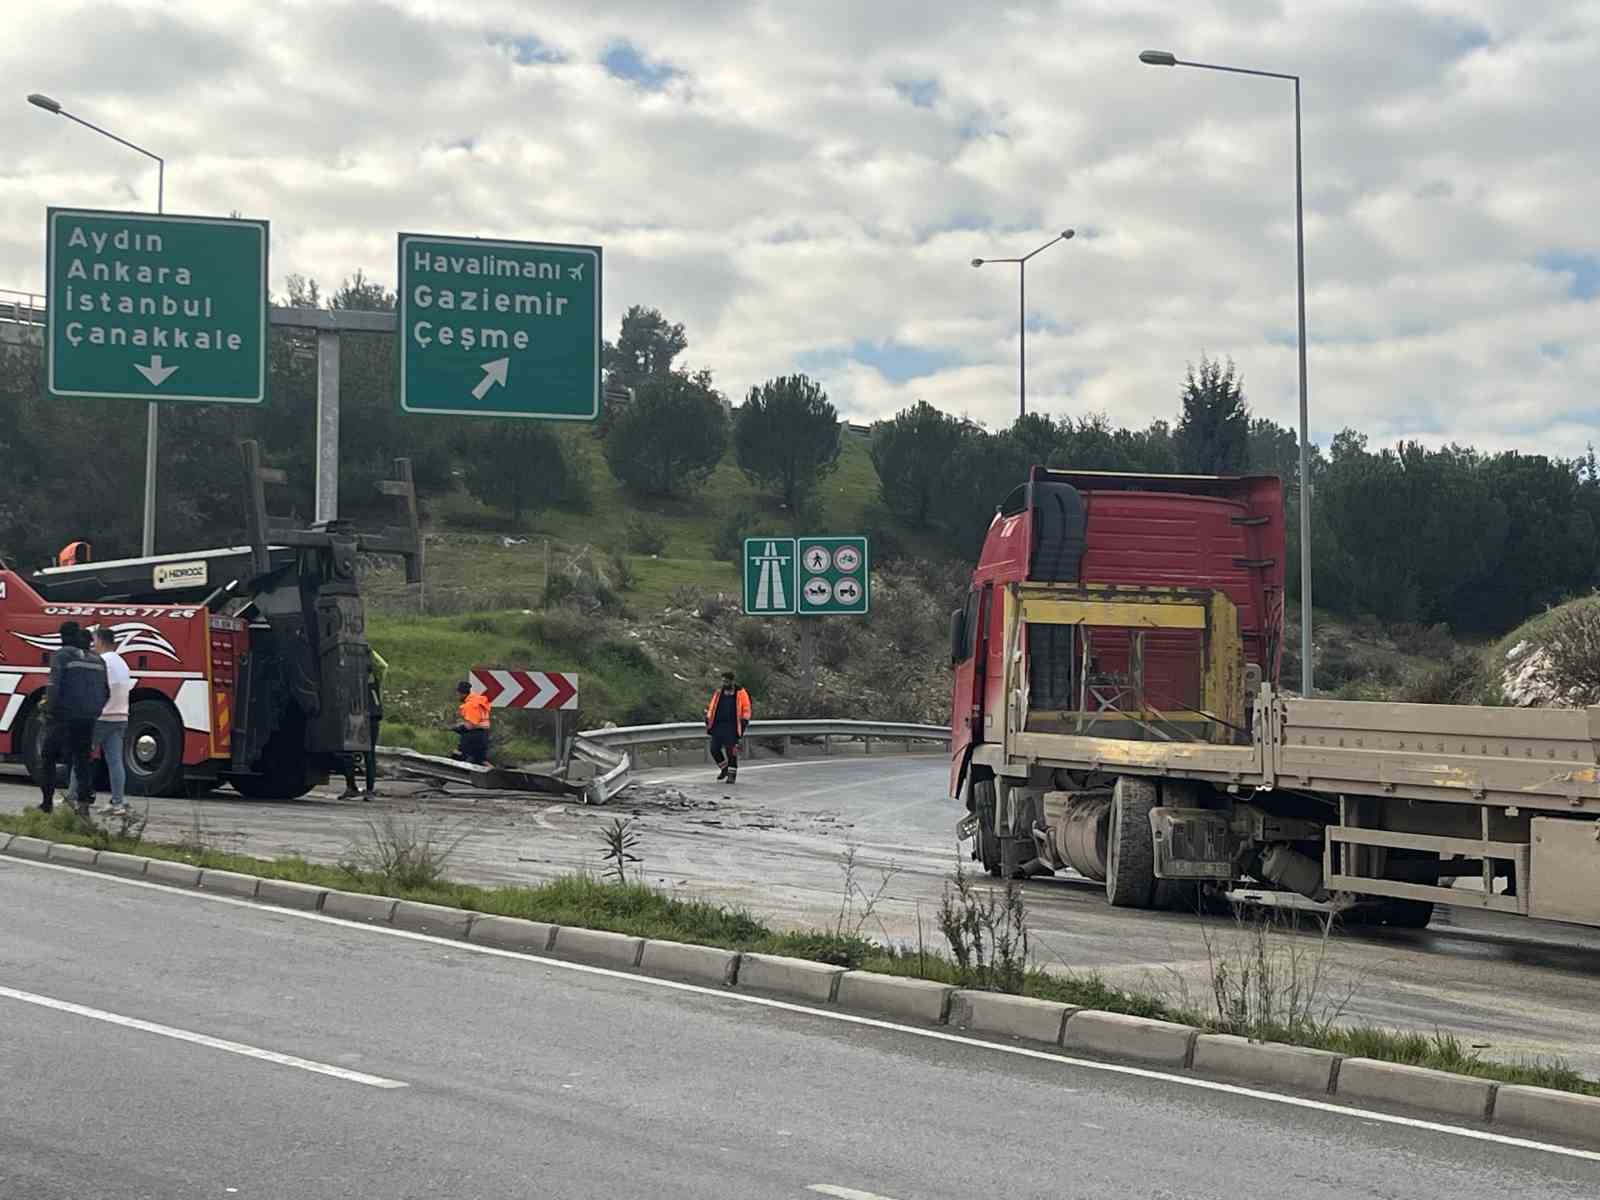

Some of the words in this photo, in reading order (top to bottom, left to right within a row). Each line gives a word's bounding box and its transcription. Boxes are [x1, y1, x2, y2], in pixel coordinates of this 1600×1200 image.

[67, 226, 163, 254] Aydın
[66, 258, 192, 285] Ankara
[413, 251, 561, 280] Havalimanı
[65, 286, 212, 318] İstanbul
[413, 285, 568, 316] Gaziemir
[65, 322, 242, 350] Çanakkale
[413, 321, 529, 351] Çeşme
